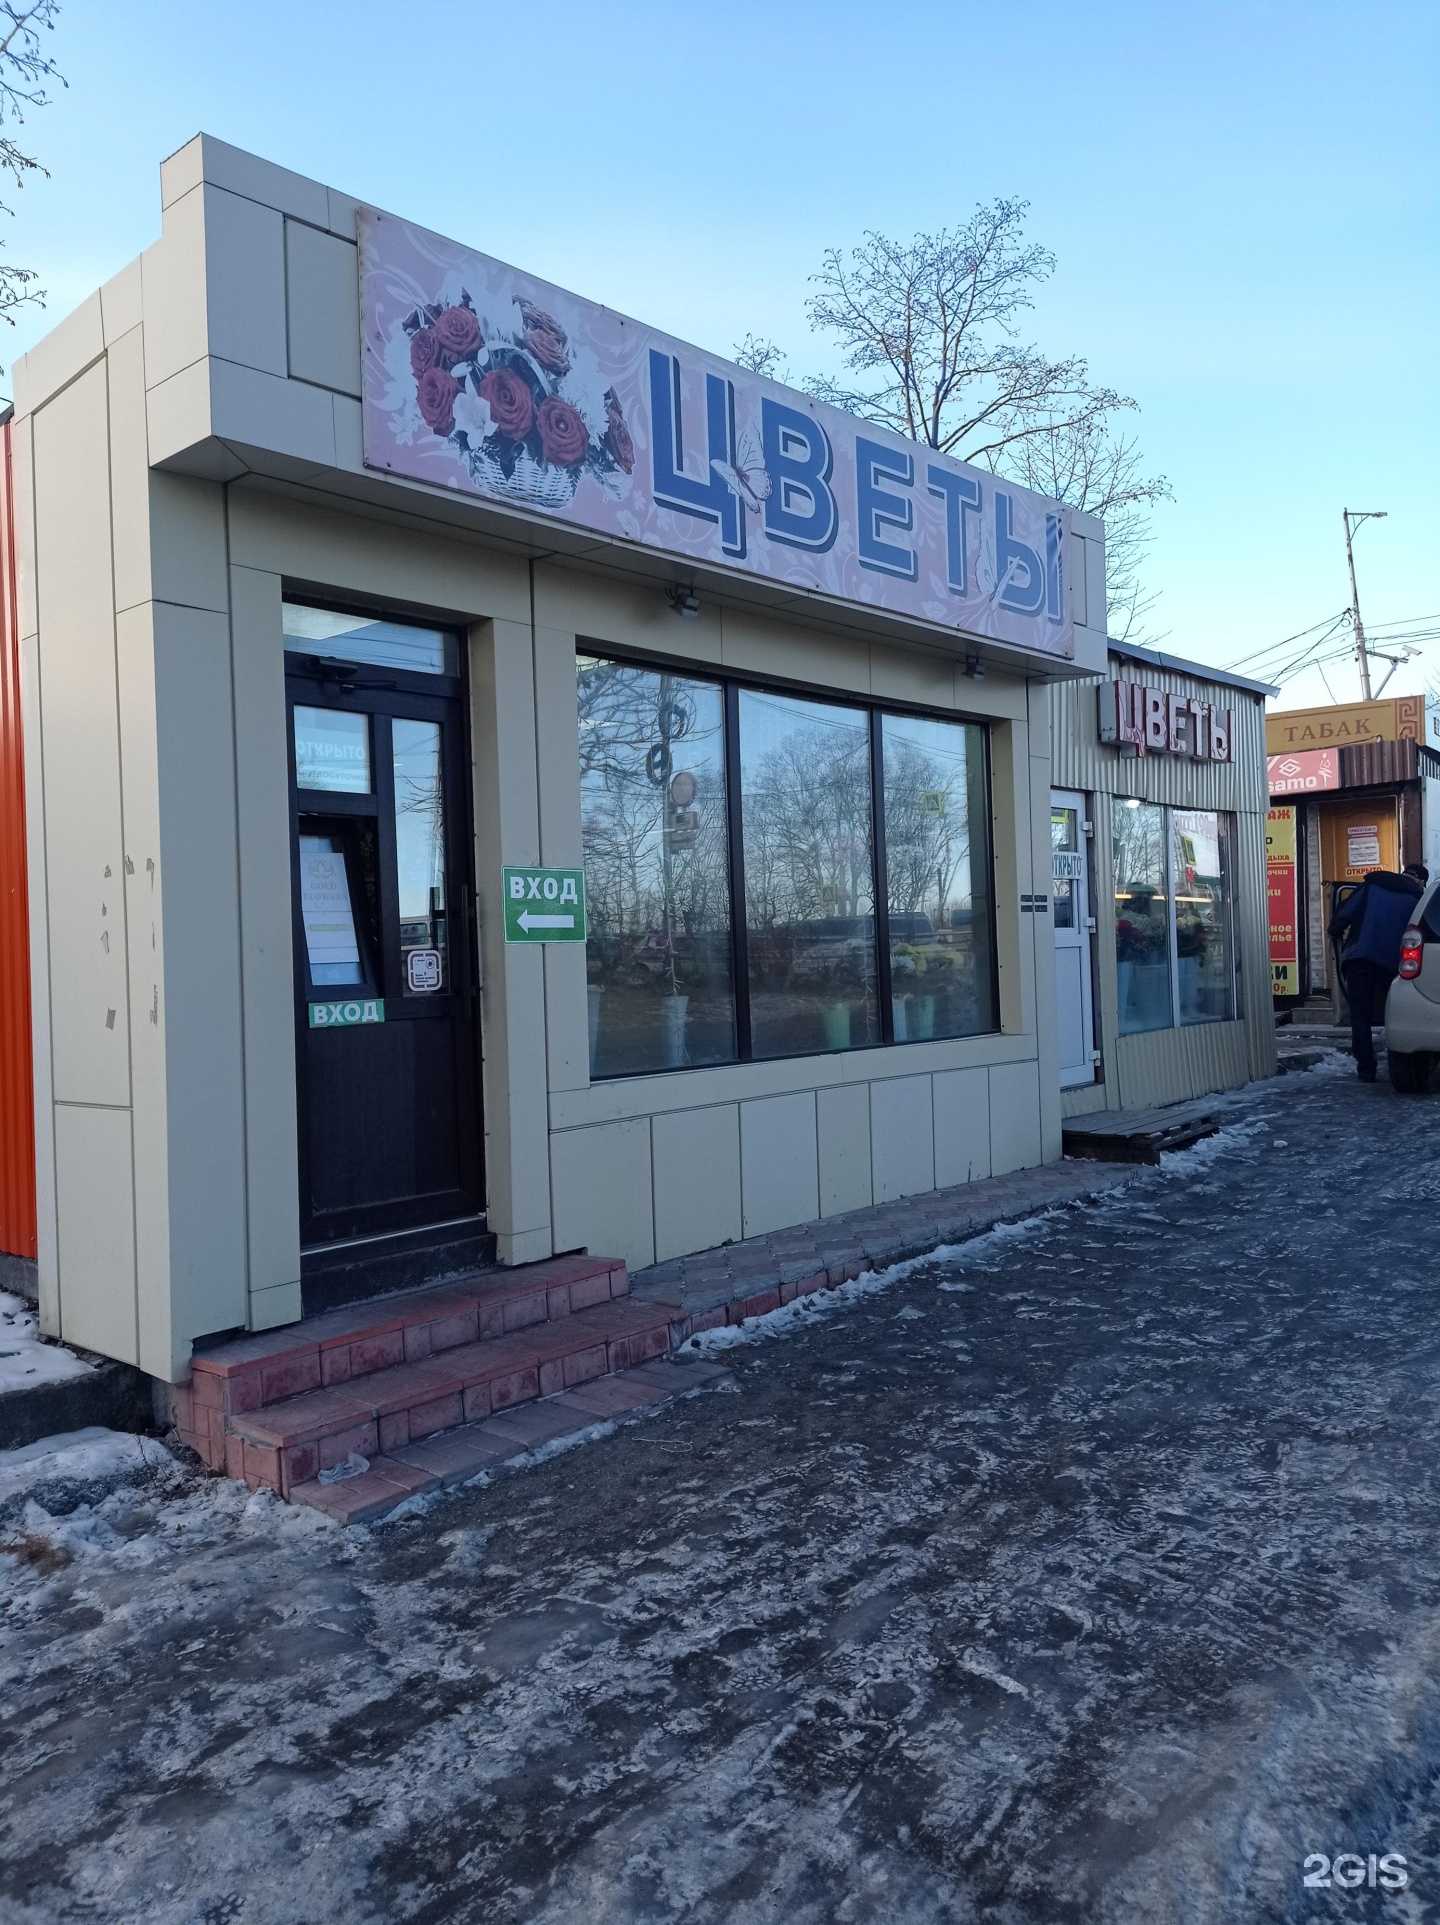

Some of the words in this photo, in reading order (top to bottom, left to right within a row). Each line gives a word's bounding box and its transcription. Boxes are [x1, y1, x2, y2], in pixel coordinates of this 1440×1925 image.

[648, 348, 1063, 625] ЦВЕТЫ
[1115, 680, 1236, 763] ЦВЕТЫ
[1284, 718, 1371, 742] ТАБАК
[1052, 854, 1082, 876] ТКРЫТО
[509, 876, 578, 905] ВХОД
[313, 1001, 379, 1024] ВХОД
